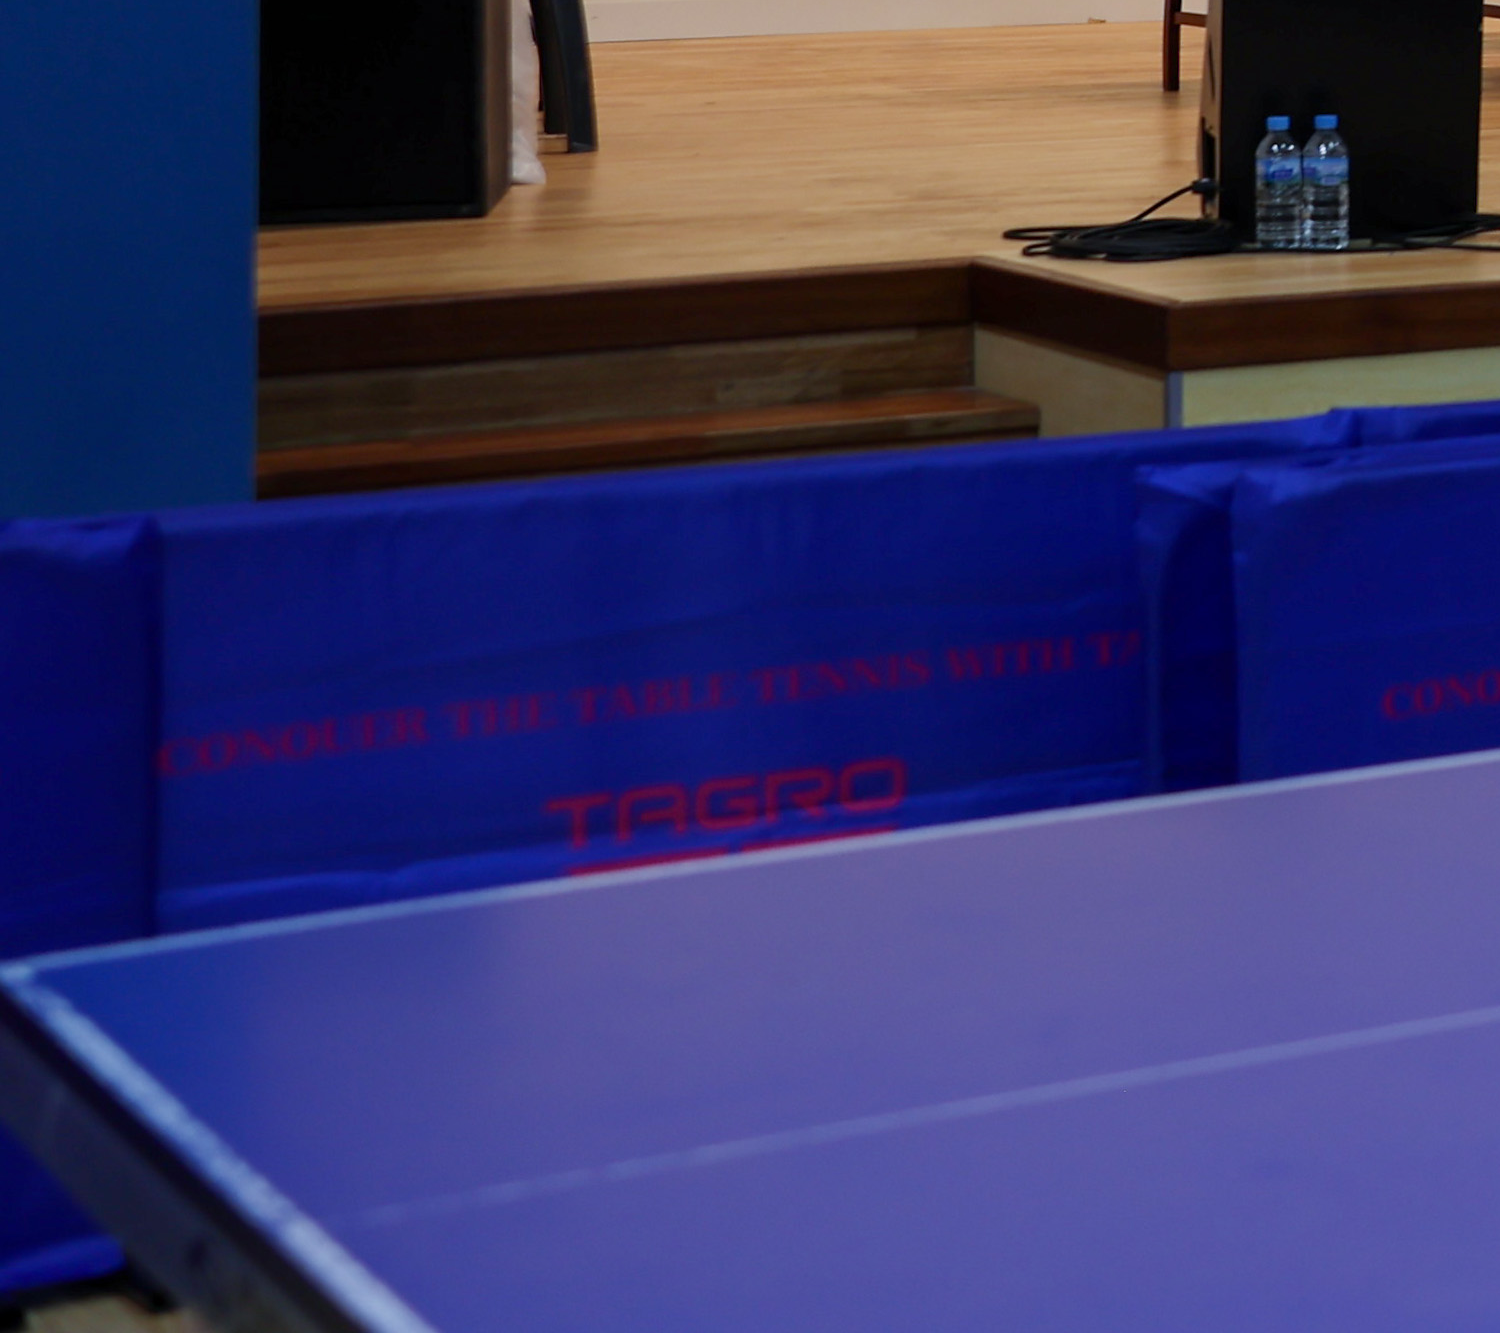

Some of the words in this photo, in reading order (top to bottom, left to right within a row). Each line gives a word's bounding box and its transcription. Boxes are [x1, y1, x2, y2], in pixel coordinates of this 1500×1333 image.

[157, 706, 431, 777] CONQUER
[440, 690, 556, 739] THE
[564, 671, 741, 727] TABLE
[748, 648, 934, 705] TENNIS
[944, 634, 1077, 683] WITH
[542, 755, 910, 852] TAGRO
